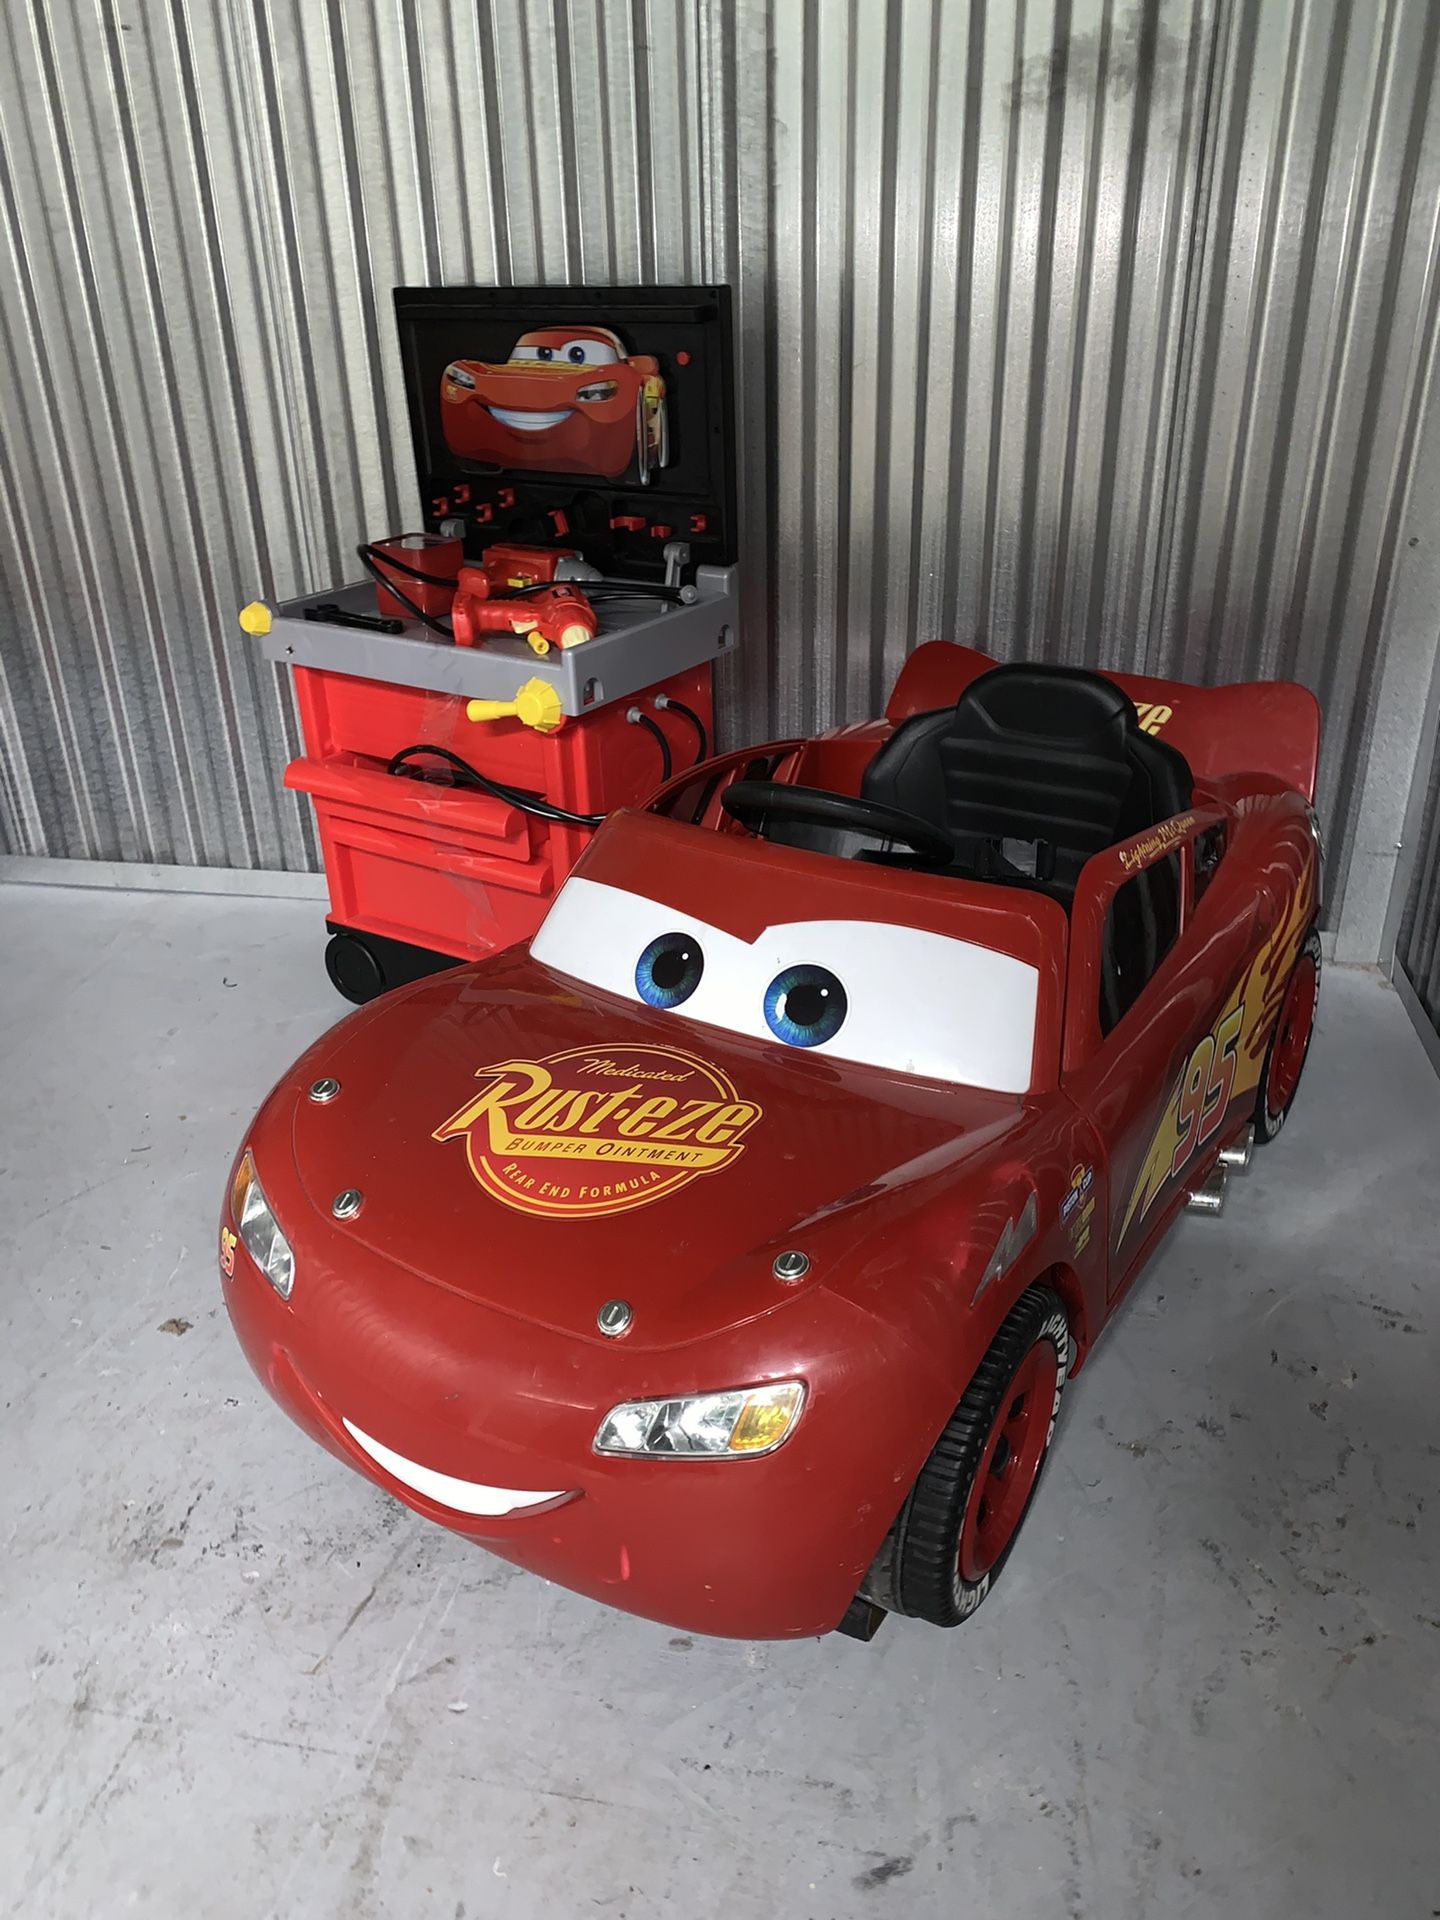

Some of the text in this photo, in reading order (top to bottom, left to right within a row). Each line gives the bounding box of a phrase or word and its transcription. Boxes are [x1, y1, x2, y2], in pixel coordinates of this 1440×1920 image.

[576, 1058, 695, 1082] Medicated
[1171, 1004, 1244, 1178] 95
[505, 1138, 704, 1163] BUMPER OINTMENT
[502, 1162, 660, 1200] REAR END FORMULA
